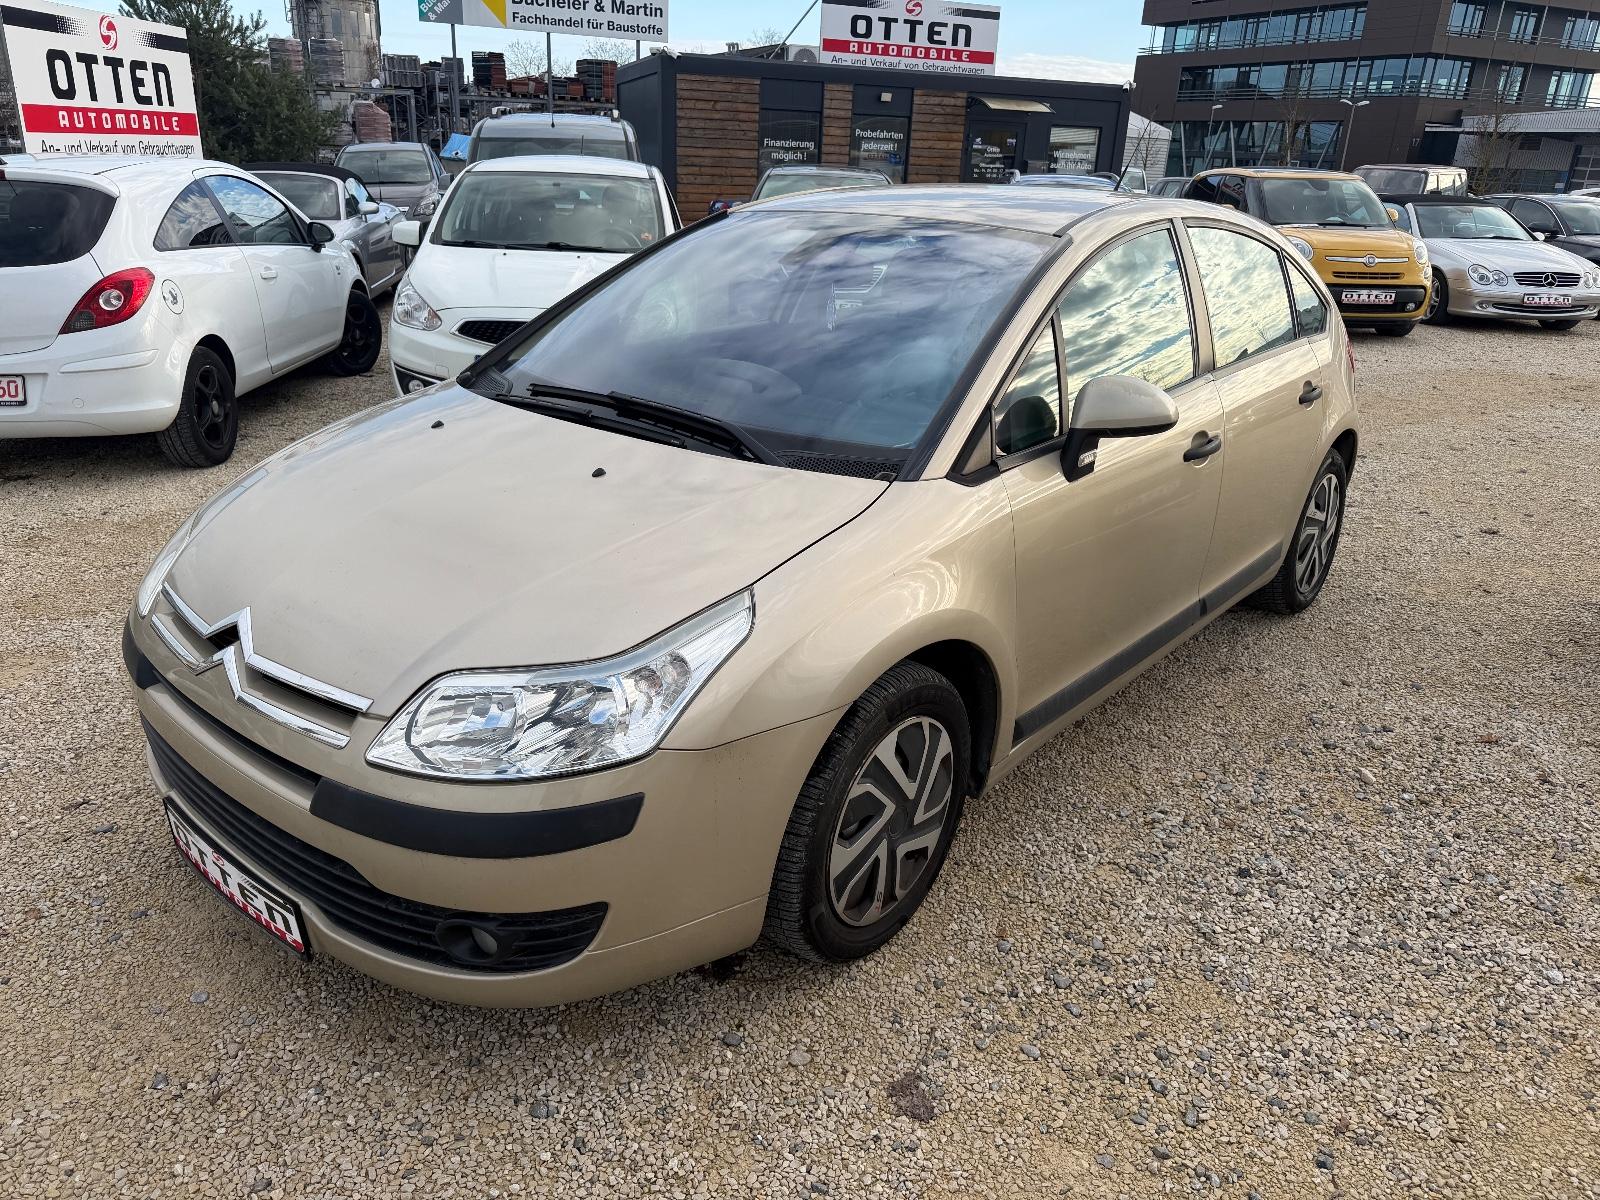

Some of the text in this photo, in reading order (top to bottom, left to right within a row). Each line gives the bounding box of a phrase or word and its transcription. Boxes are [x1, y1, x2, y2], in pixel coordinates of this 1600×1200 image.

[428, 12, 437, 20] &
[594, 0, 605, 12] &
[611, 0, 663, 17] Martin
[512, 12, 663, 35] Fachhandel für Baustoffe
[850, 14, 972, 47] OTTEN
[850, 42, 970, 62] AUTOMOBILE
[831, 55, 985, 75] An- und Verkauf von Gebrauchtwagen
[46, 49, 174, 107] OTTEN
[58, 110, 180, 132] AUTOMOBILE
[764, 138, 815, 150] Finanzierung
[855, 129, 904, 140] Probefahrten
[41, 140, 195, 158] An- und Verkauf von Gebrauchtwagen
[771, 151, 802, 161] möglich
[861, 142, 893, 151] jederzeit
[174, 821, 294, 936] OTTEN
[180, 843, 297, 947] AUTOMOBILE
